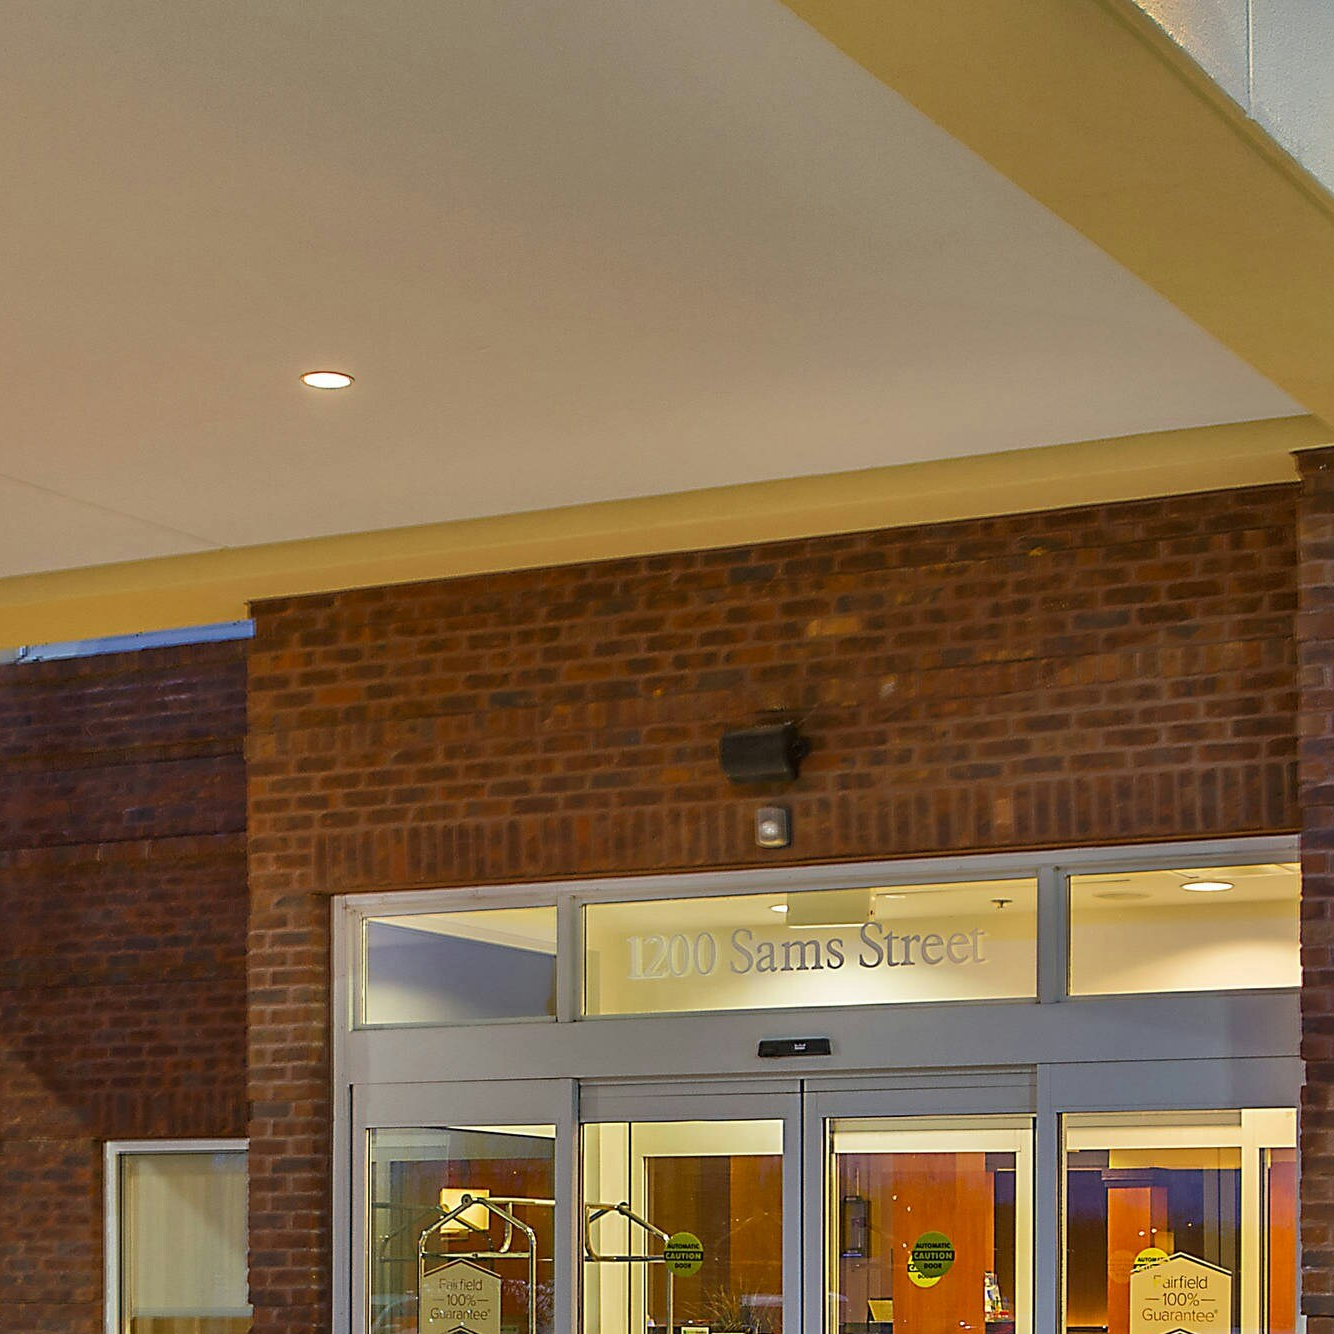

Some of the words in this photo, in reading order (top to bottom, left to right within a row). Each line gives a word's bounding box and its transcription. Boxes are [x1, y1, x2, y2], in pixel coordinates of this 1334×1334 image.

[626, 932, 717, 980] 1200
[730, 928, 845, 975] Sams
[859, 921, 987, 968] Street
[665, 1252, 702, 1260] CAUTION
[913, 1252, 953, 1260] CAUTION
[438, 1278, 483, 1291] Fairfield
[447, 1293, 477, 1306] 100%
[1162, 1292, 1200, 1307] 100%
